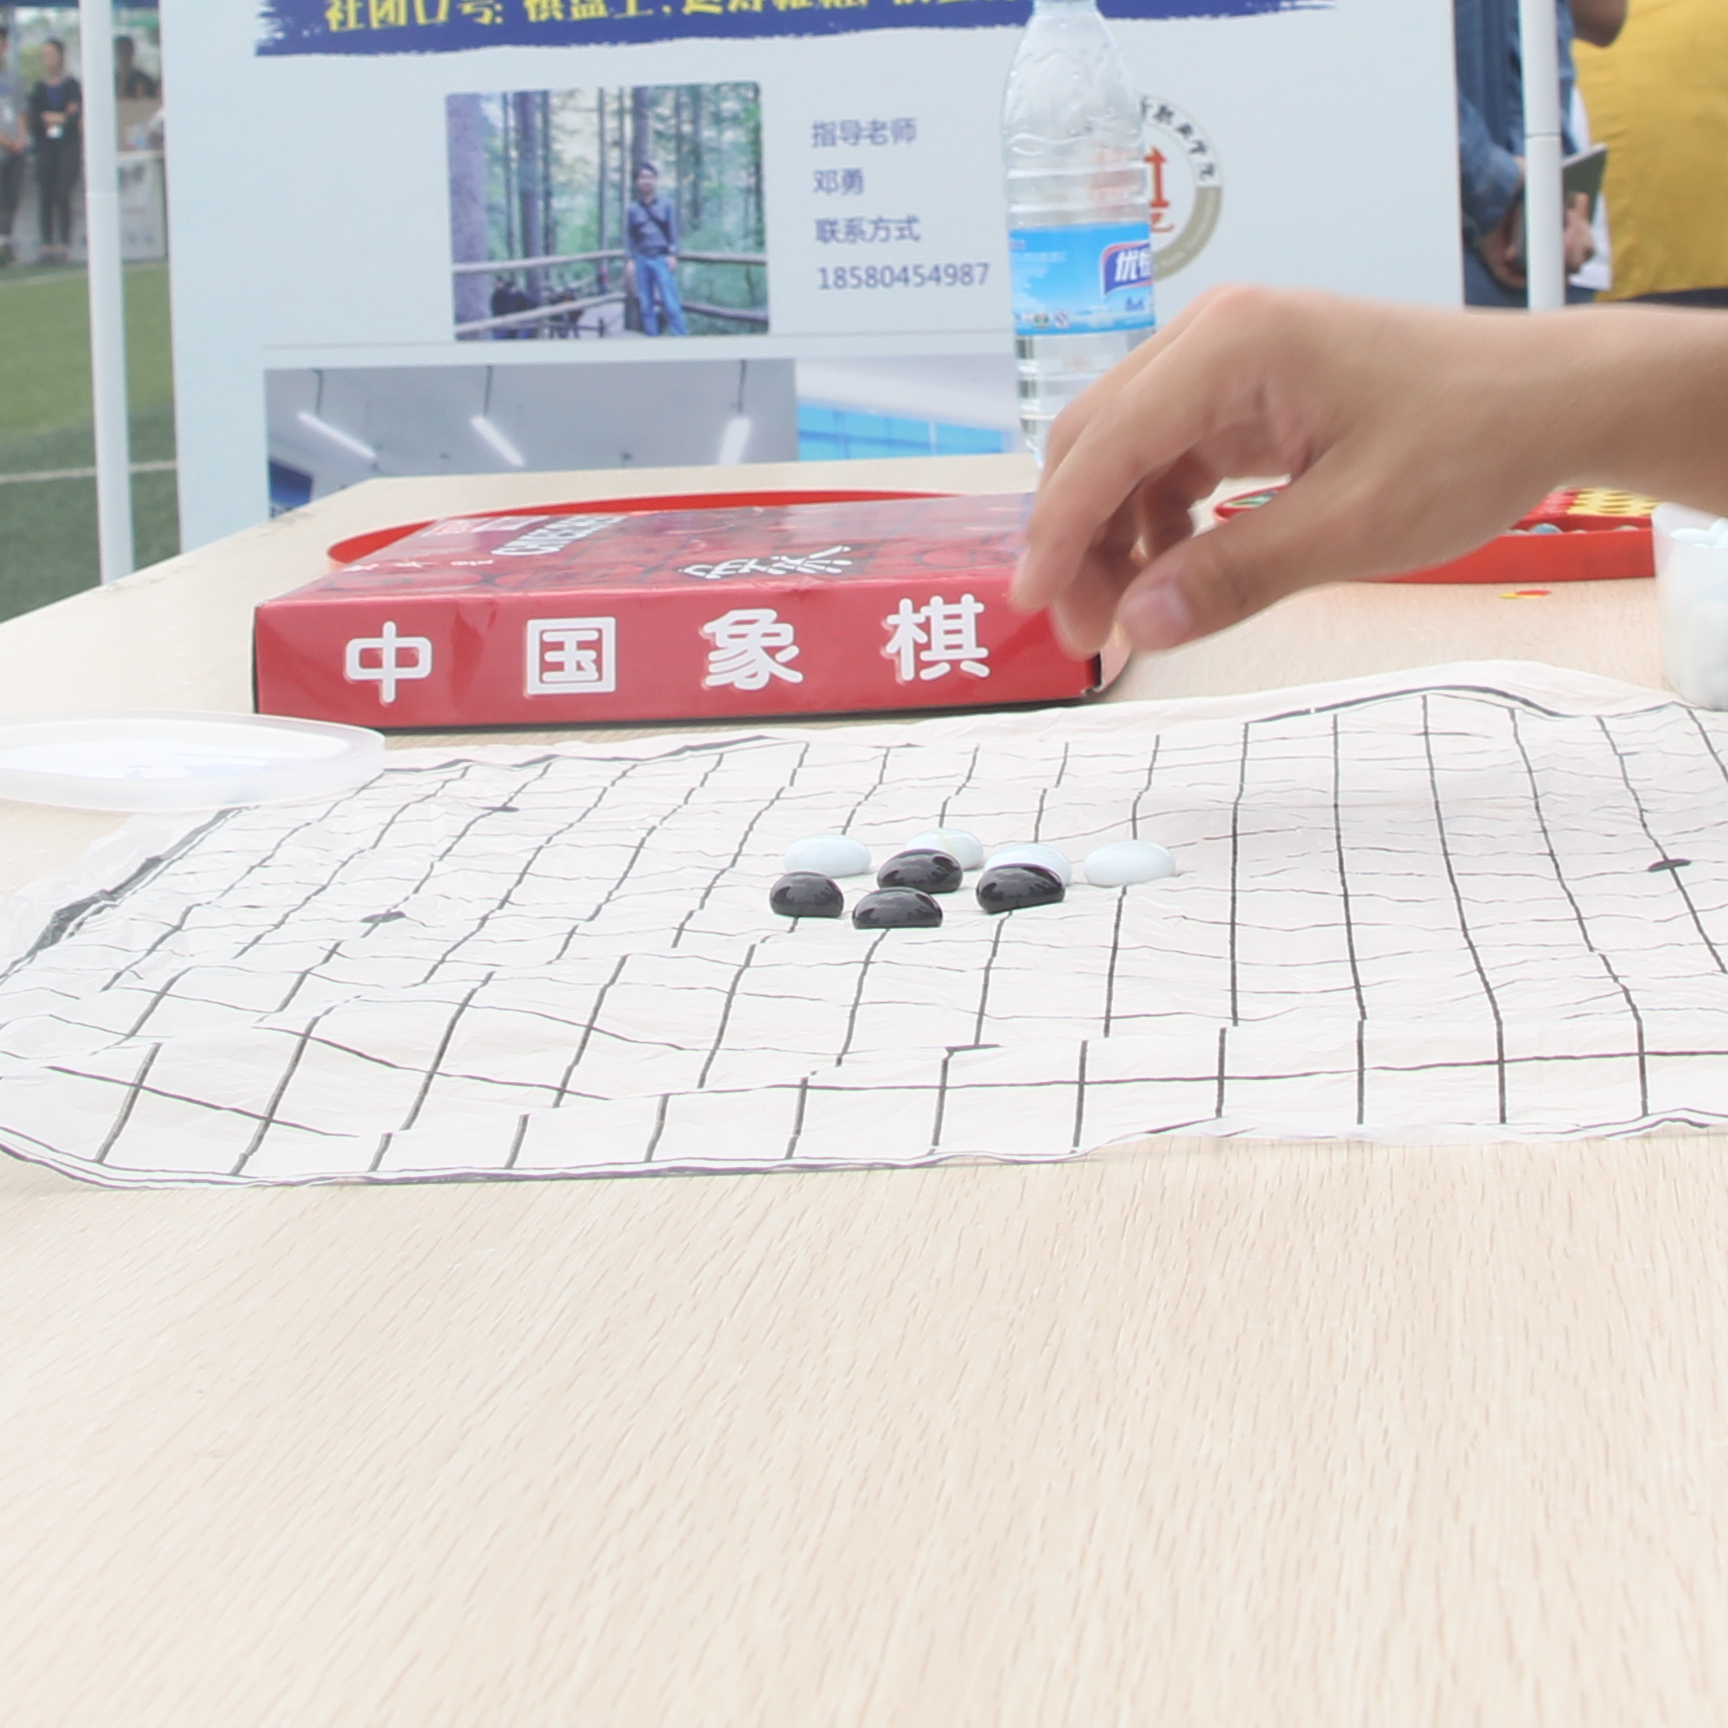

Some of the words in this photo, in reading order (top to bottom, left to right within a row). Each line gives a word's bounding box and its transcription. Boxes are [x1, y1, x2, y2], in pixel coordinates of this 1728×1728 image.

[812, 117, 918, 149] 指导老师
[813, 167, 865, 196] 邓勇
[815, 214, 922, 245] 联系方式
[818, 260, 991, 291] 18580454987
[344, 593, 991, 705] 中国象棋
